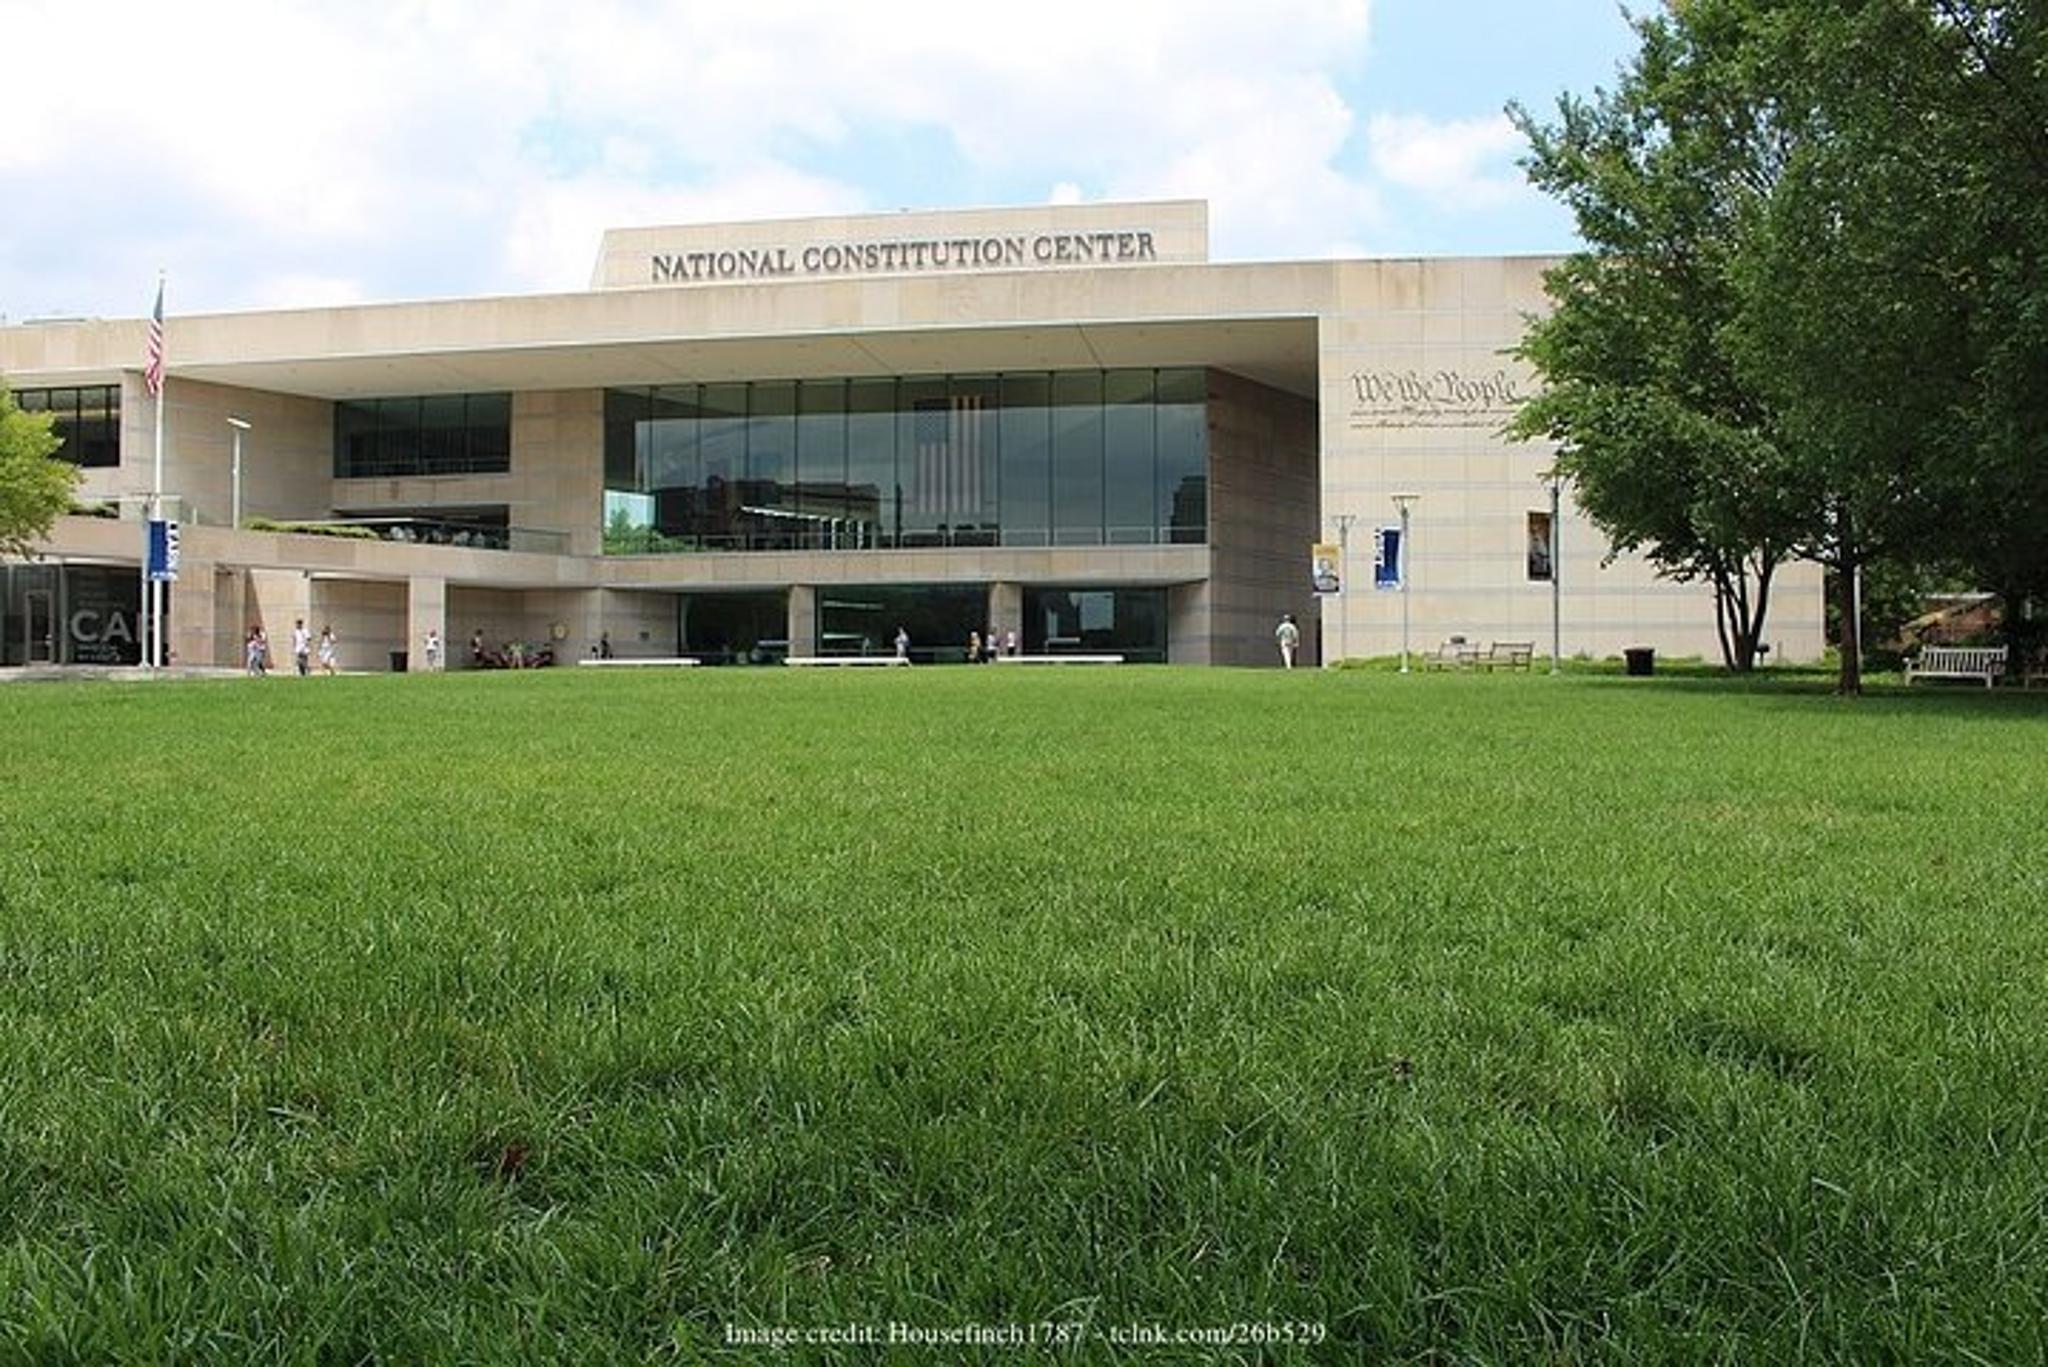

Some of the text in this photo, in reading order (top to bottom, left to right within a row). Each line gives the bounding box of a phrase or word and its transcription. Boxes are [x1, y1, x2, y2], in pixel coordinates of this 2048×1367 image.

[652, 232, 1157, 282] NATIONAL CONSTITUTION CENTER
[1352, 372, 1393, 402] We
[1434, 369, 1525, 408] People
